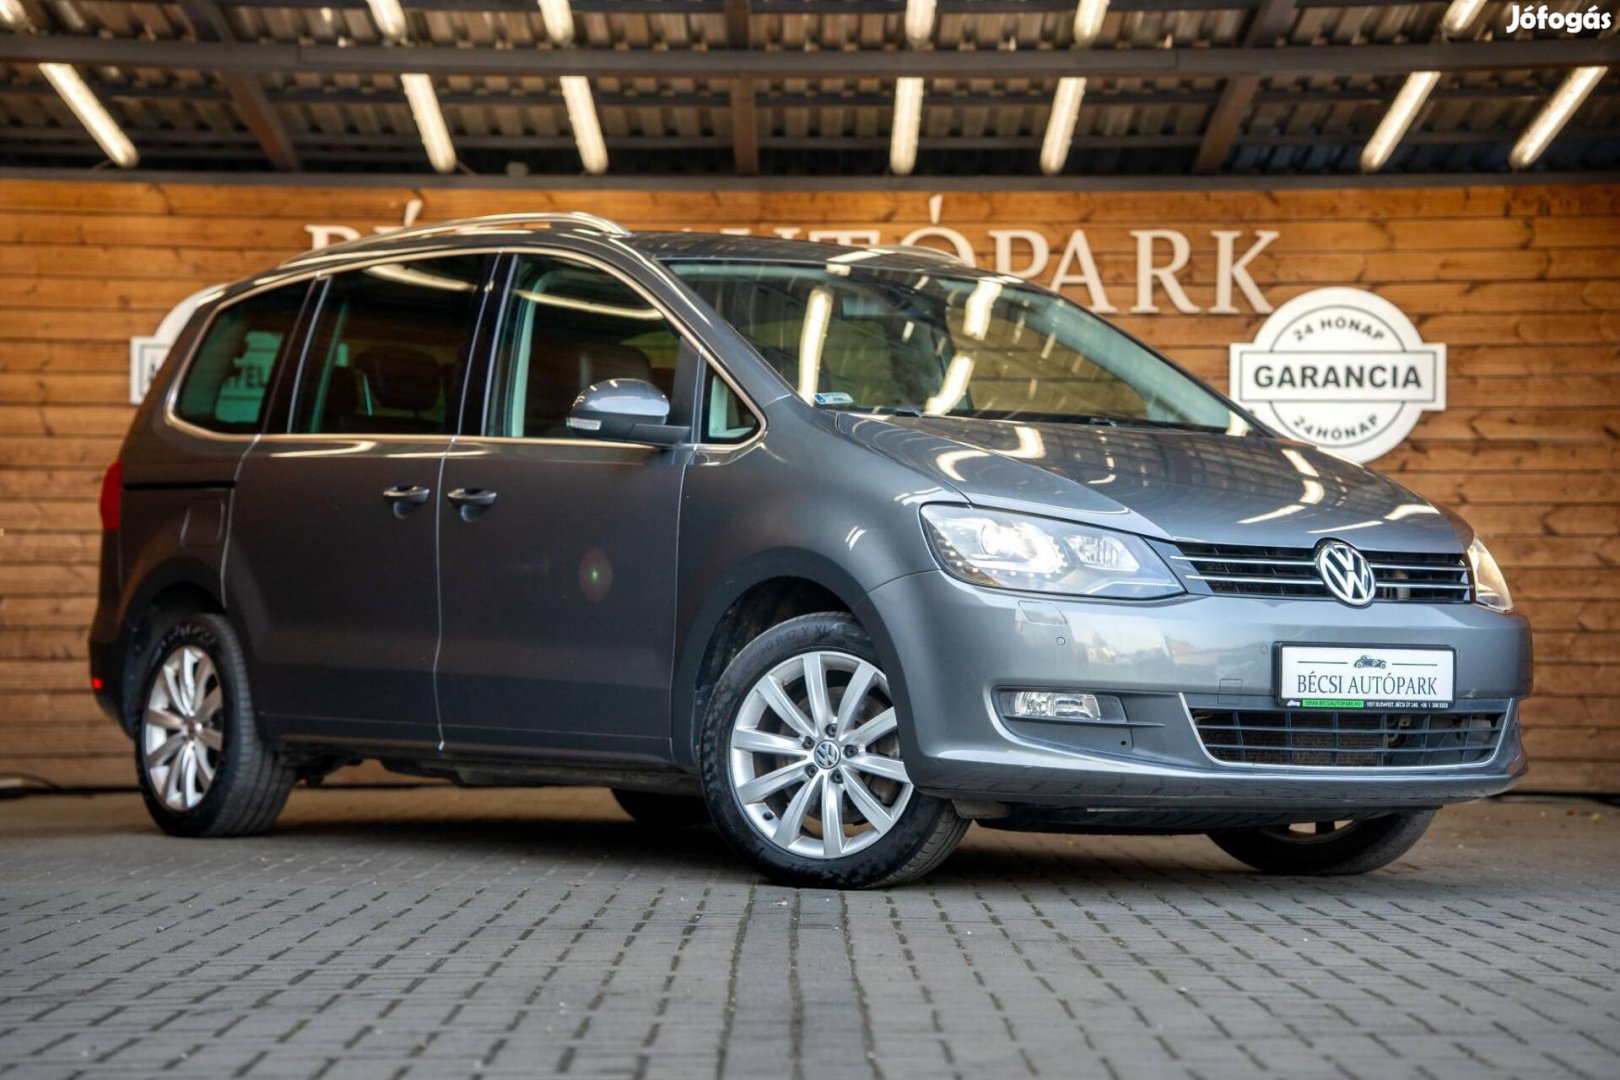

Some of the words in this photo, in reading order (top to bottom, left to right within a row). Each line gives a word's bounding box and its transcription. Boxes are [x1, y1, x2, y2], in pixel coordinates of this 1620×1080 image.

[1293, 324, 1314, 341] 24
[1253, 363, 1424, 389] GARANCIA
[1297, 671, 1343, 694] BÉCSI
[1347, 672, 1438, 696] AUTÓPARK
